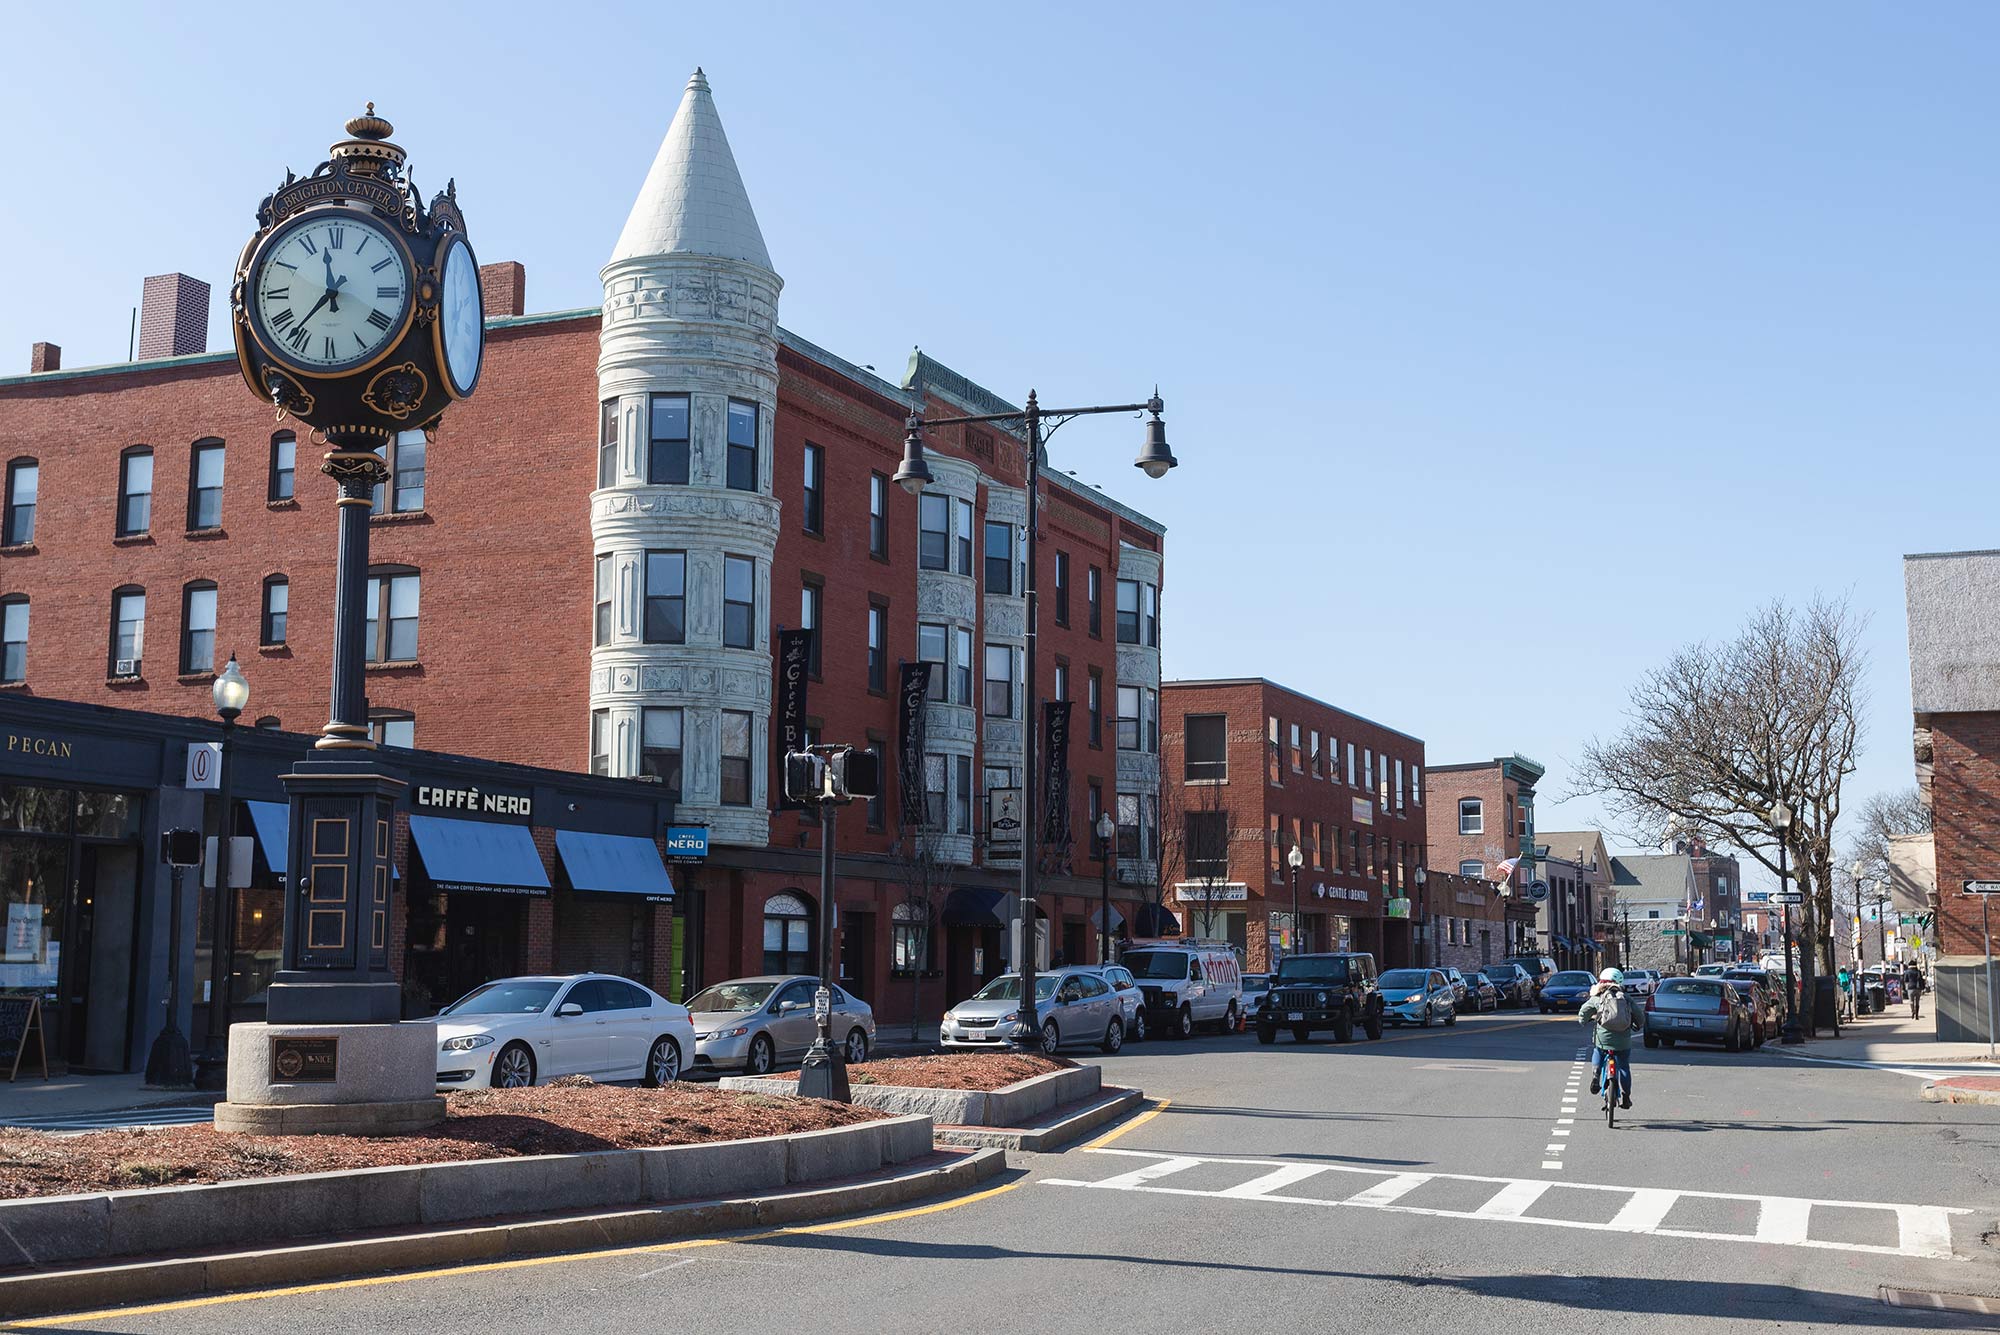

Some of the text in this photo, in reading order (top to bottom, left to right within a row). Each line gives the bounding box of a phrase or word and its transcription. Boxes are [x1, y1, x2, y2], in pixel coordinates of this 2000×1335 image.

[284, 181, 391, 207] BRIGHTON CENTER
[8, 735, 72, 758] PECAN
[418, 786, 531, 816] CAFFÈ NERO
[668, 839, 705, 849] NERO
[1329, 886, 1368, 901] GENTLE DENTAL
